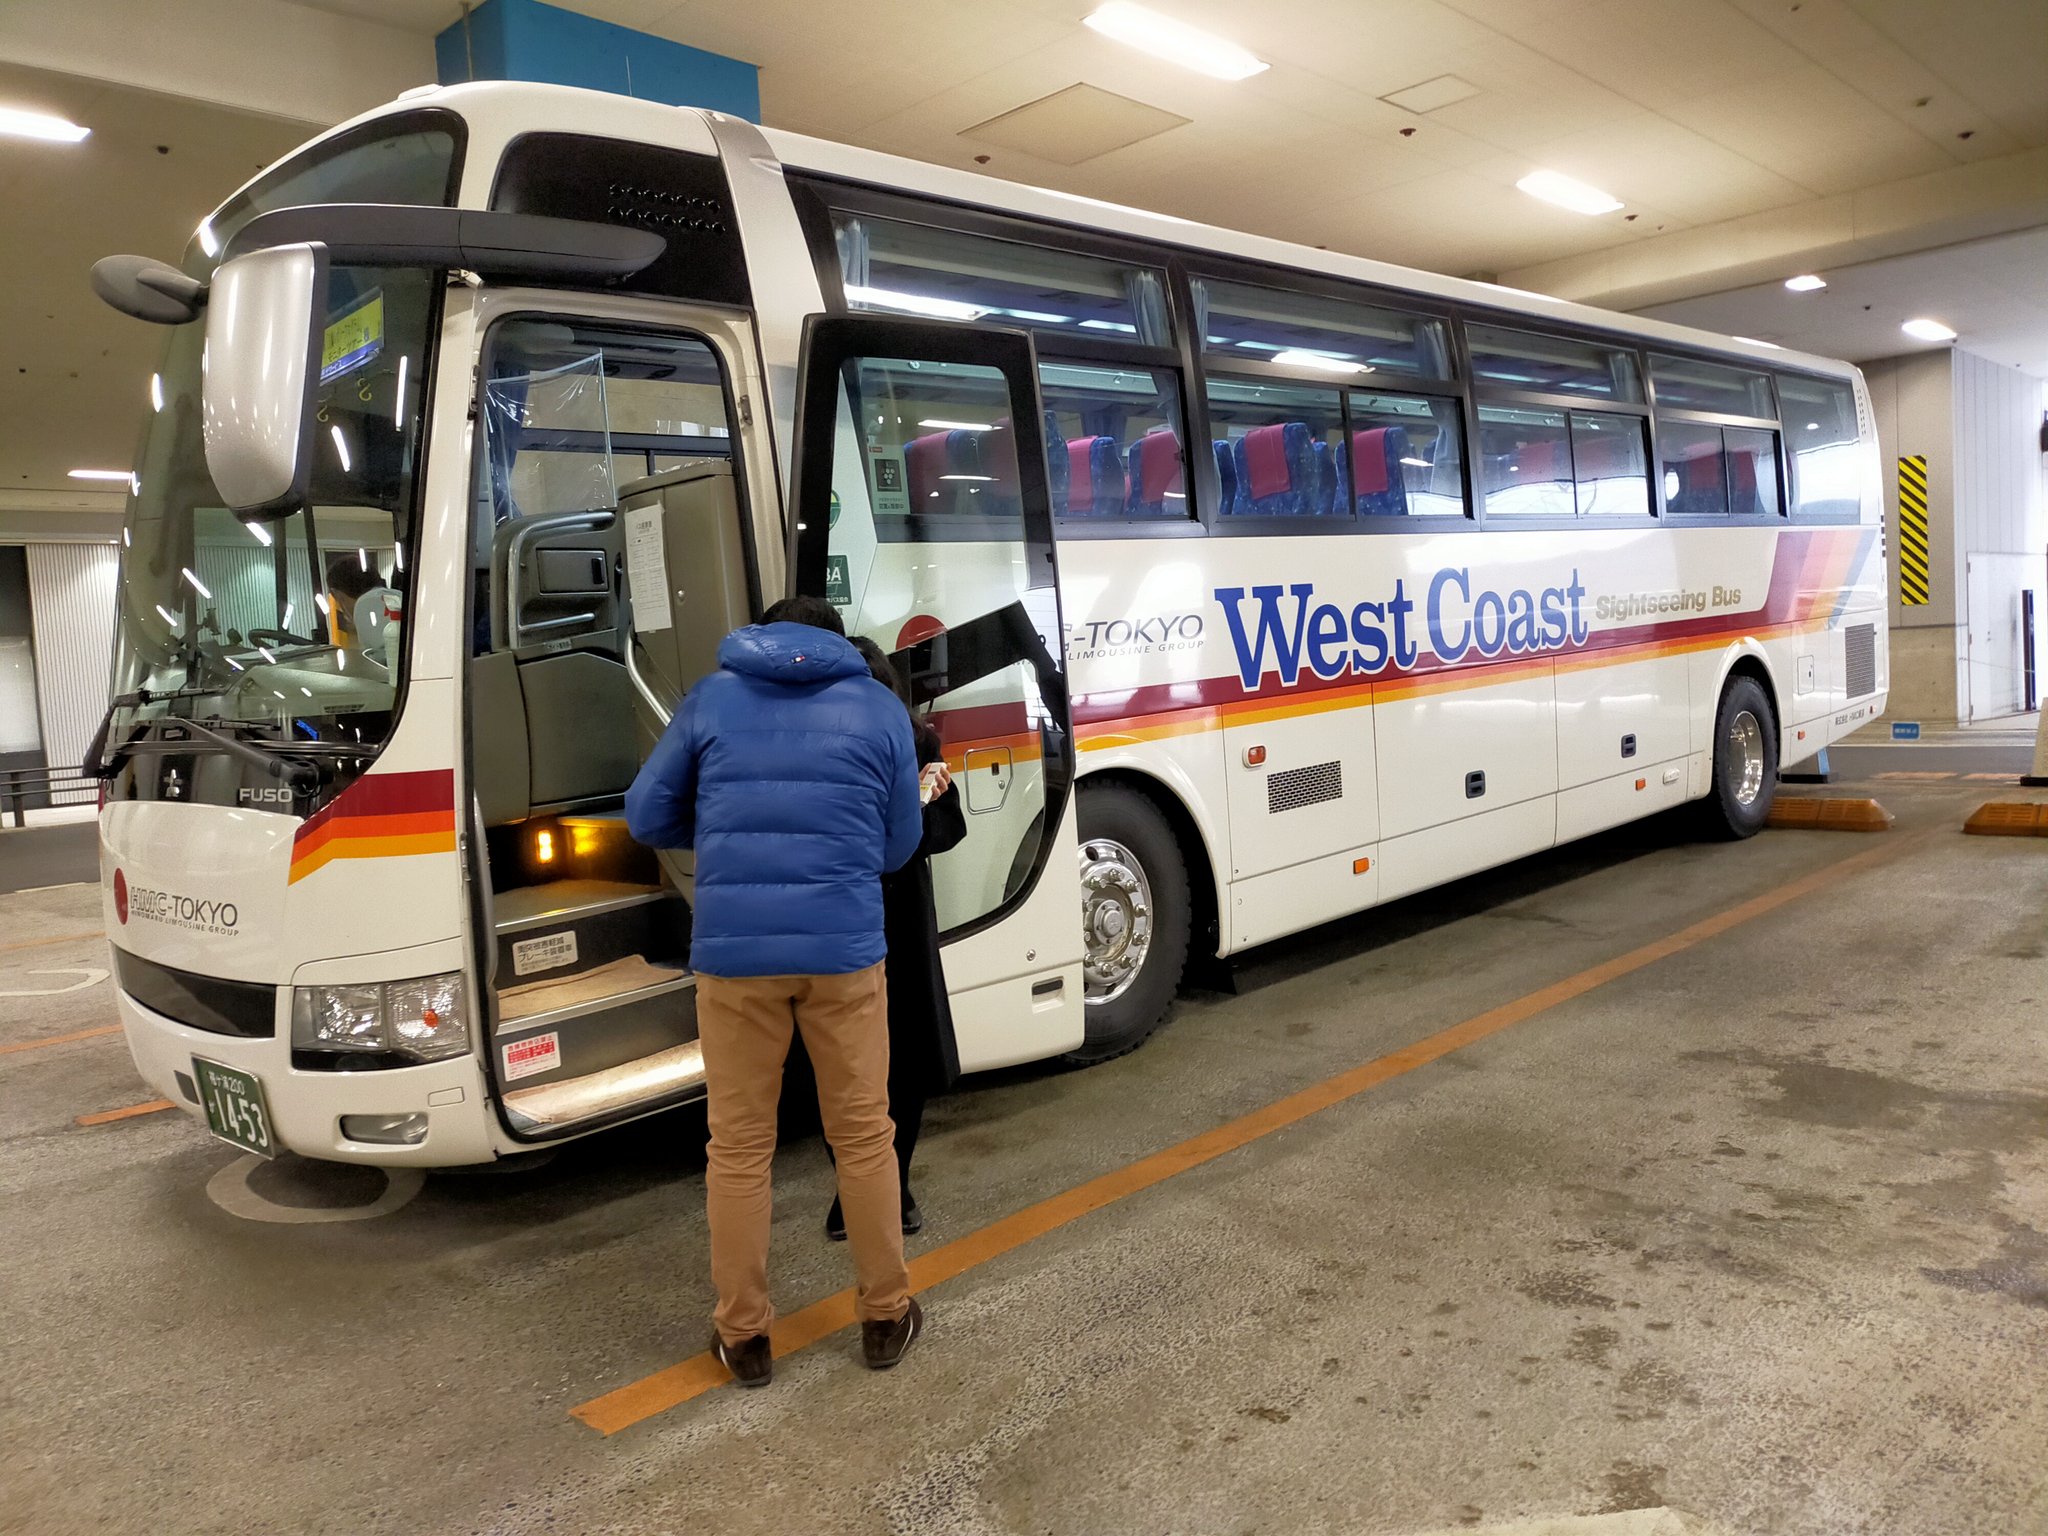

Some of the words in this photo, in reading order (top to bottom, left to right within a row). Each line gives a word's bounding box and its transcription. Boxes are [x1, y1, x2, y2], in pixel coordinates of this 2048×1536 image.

[1595, 589, 1707, 622] Sightseeing
[1711, 585, 1742, 607] Bus
[1213, 578, 1417, 689] West
[1426, 566, 1589, 661] Coast
[1068, 645, 1151, 661] LIMOUSINE
[1158, 640, 1205, 652] GROUP
[239, 787, 293, 803] FUSO
[130, 886, 239, 927] HMC-TOKYO
[165, 917, 205, 932] LIMOUSINE
[208, 925, 240, 937] GROUP
[214, 1089, 268, 1148] 14-53
